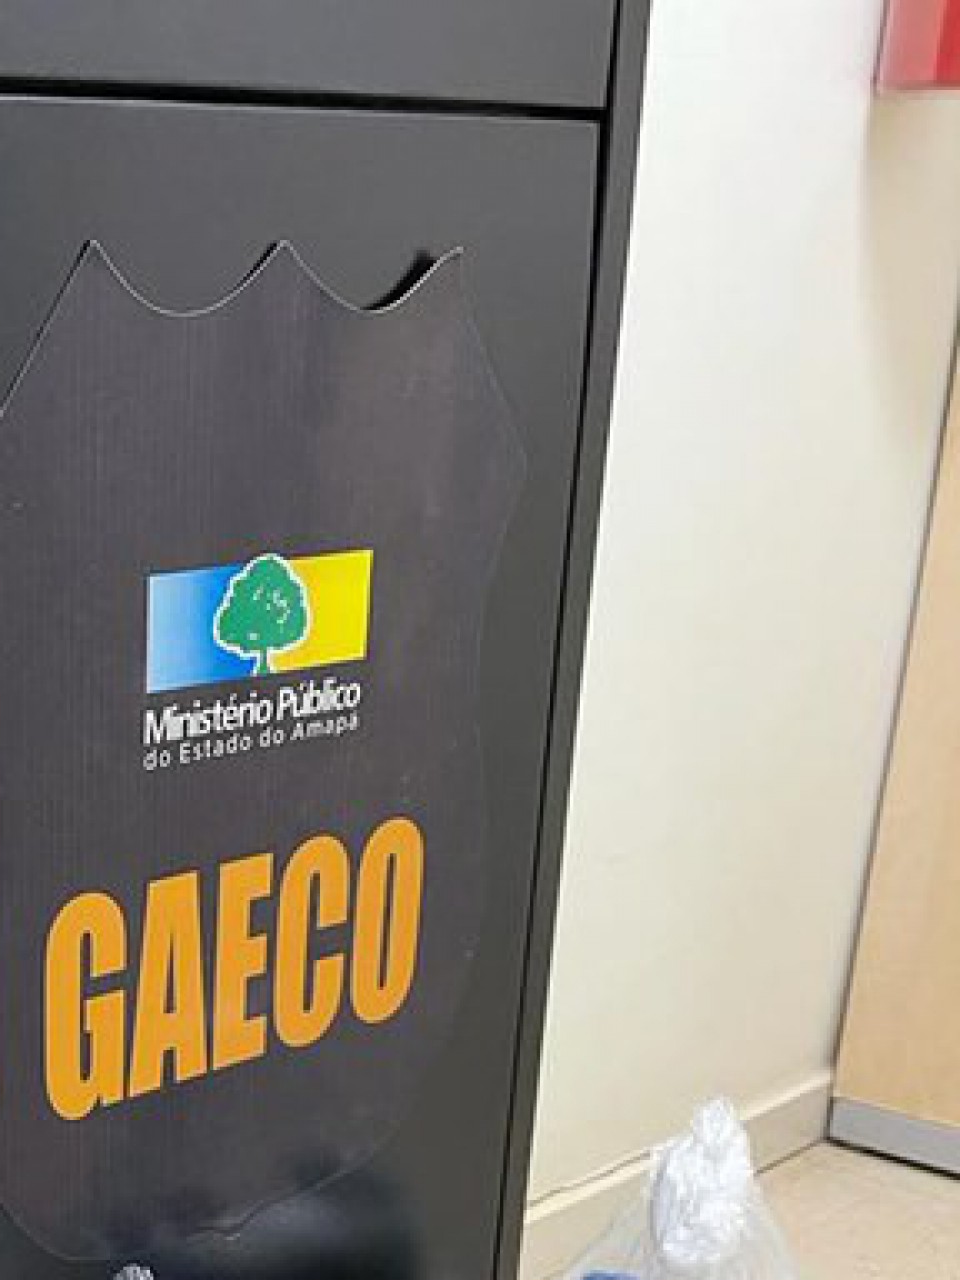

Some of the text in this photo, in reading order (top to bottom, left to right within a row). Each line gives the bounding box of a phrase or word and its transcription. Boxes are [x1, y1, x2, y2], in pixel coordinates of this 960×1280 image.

[143, 676, 361, 744] Ministério Público
[143, 749, 171, 771] do
[179, 733, 251, 764] Estado
[259, 726, 284, 748] do
[44, 815, 426, 1121] GAECO
